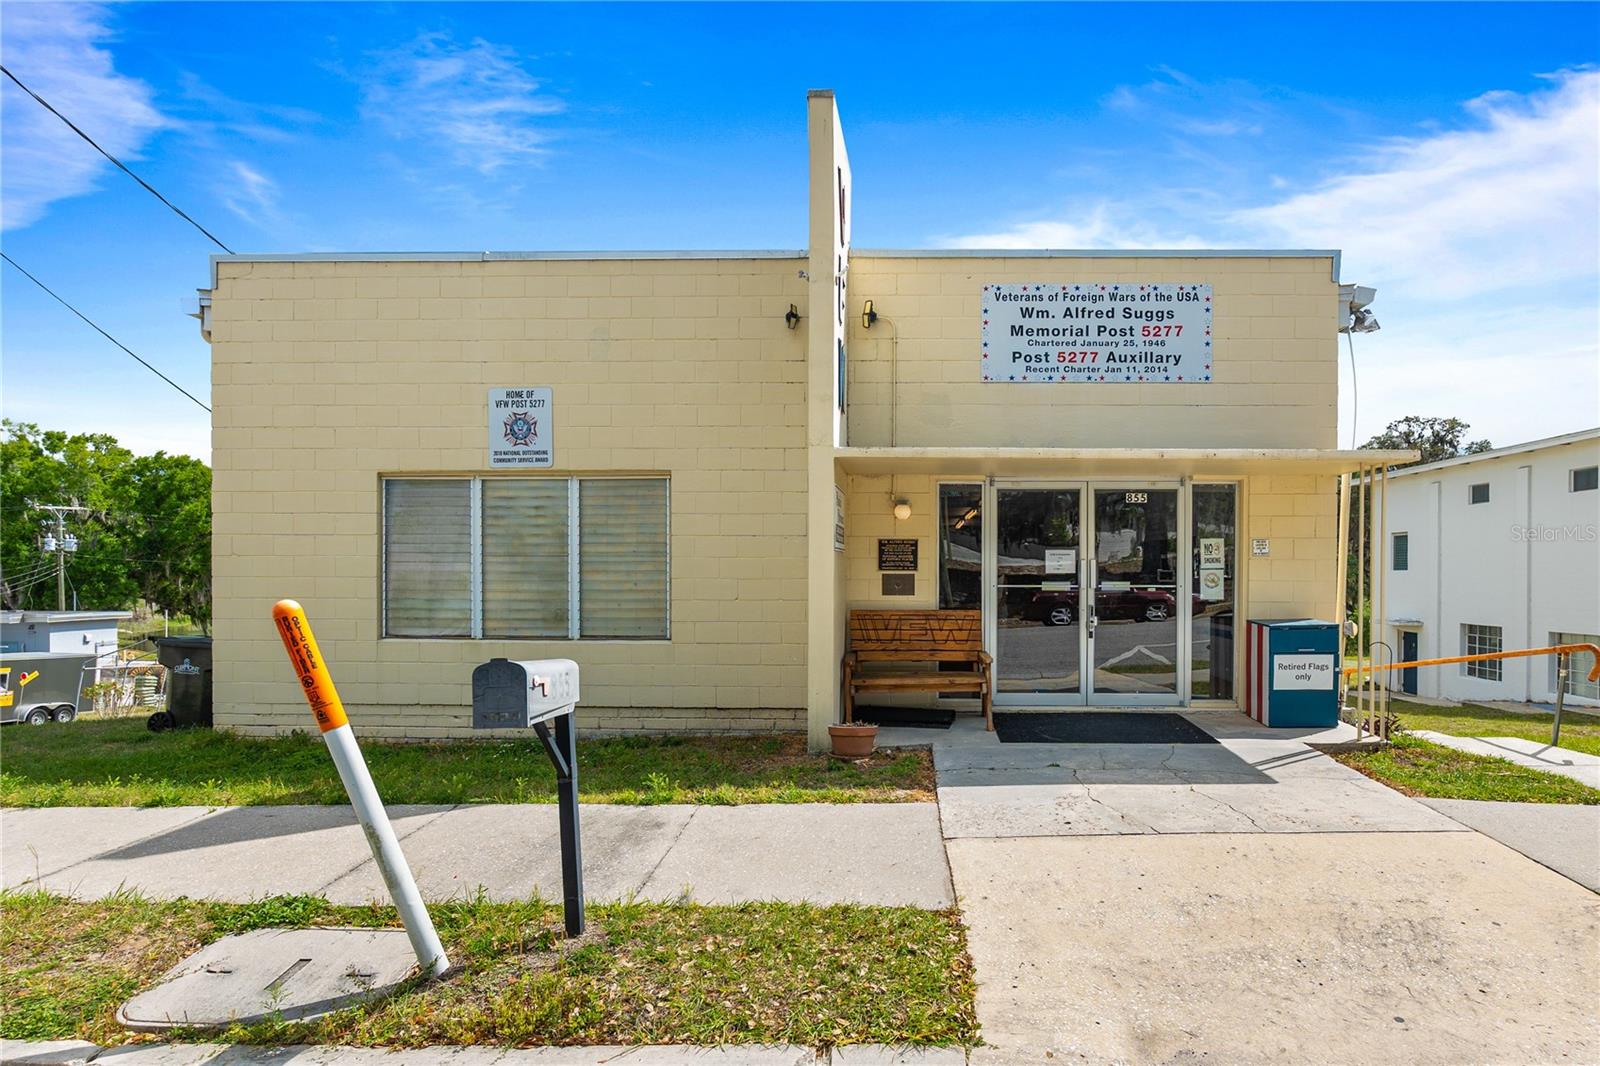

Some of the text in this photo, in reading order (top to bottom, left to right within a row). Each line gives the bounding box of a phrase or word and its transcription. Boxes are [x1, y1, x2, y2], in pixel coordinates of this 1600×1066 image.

[994, 291, 1200, 305] Veterans of Foreign Wars of the USA
[1020, 306, 1175, 323] Wm. Alfred Suggs
[1010, 324, 1184, 338] Memorial Post 5277
[1027, 339, 1166, 349] Chartered January 25, 1946
[1012, 351, 1182, 366] Post 5277 Auxillary
[1025, 365, 1169, 375] Recent Charter Jan 11, 2014
[505, 390, 535, 399] HOME OF
[495, 400, 545, 408] VFW POST 5277
[1127, 493, 1146, 502] 855
[1204, 543, 1213, 554] NO
[856, 614, 975, 645] VFW
[1278, 663, 1330, 672] Retired Flags
[1295, 672, 1312, 682] only
